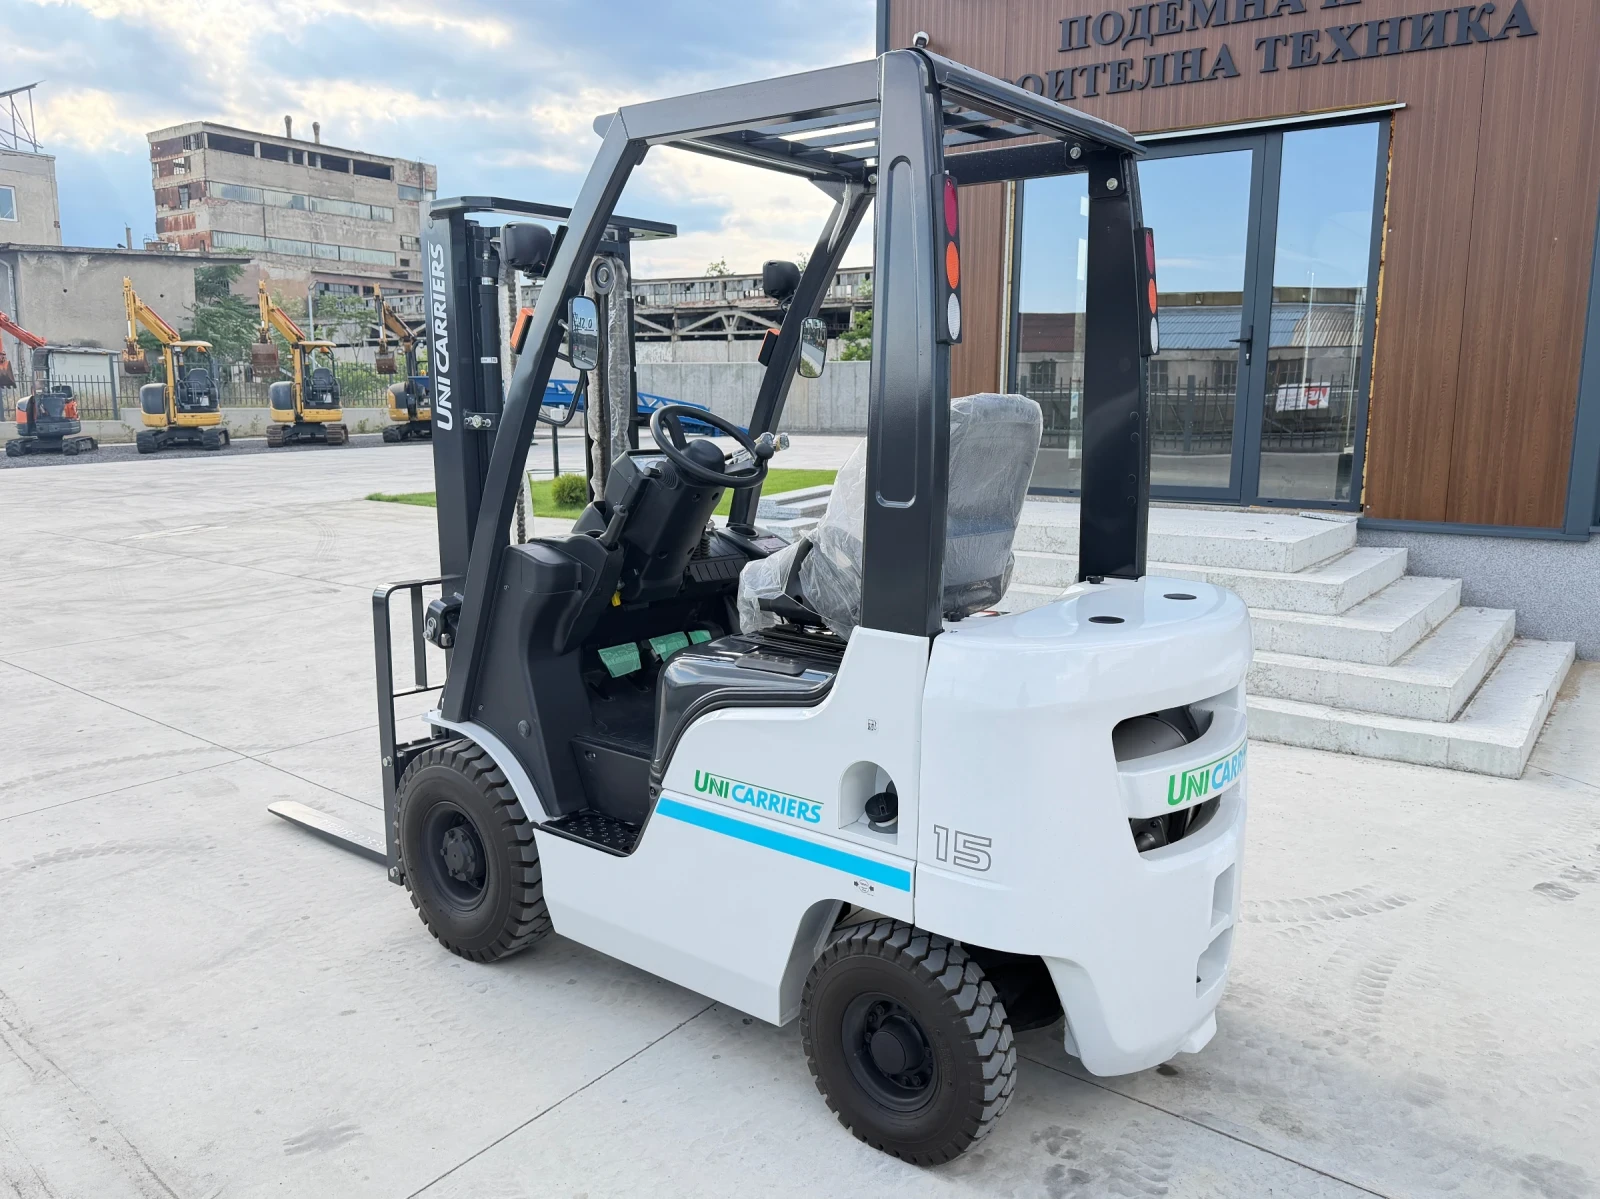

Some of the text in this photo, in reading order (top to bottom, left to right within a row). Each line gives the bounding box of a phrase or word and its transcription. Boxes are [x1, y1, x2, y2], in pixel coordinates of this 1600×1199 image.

[1000, 0, 1539, 101] ОИТЕЛНА ТЕХНИКА
[933, 824, 992, 872] 15
